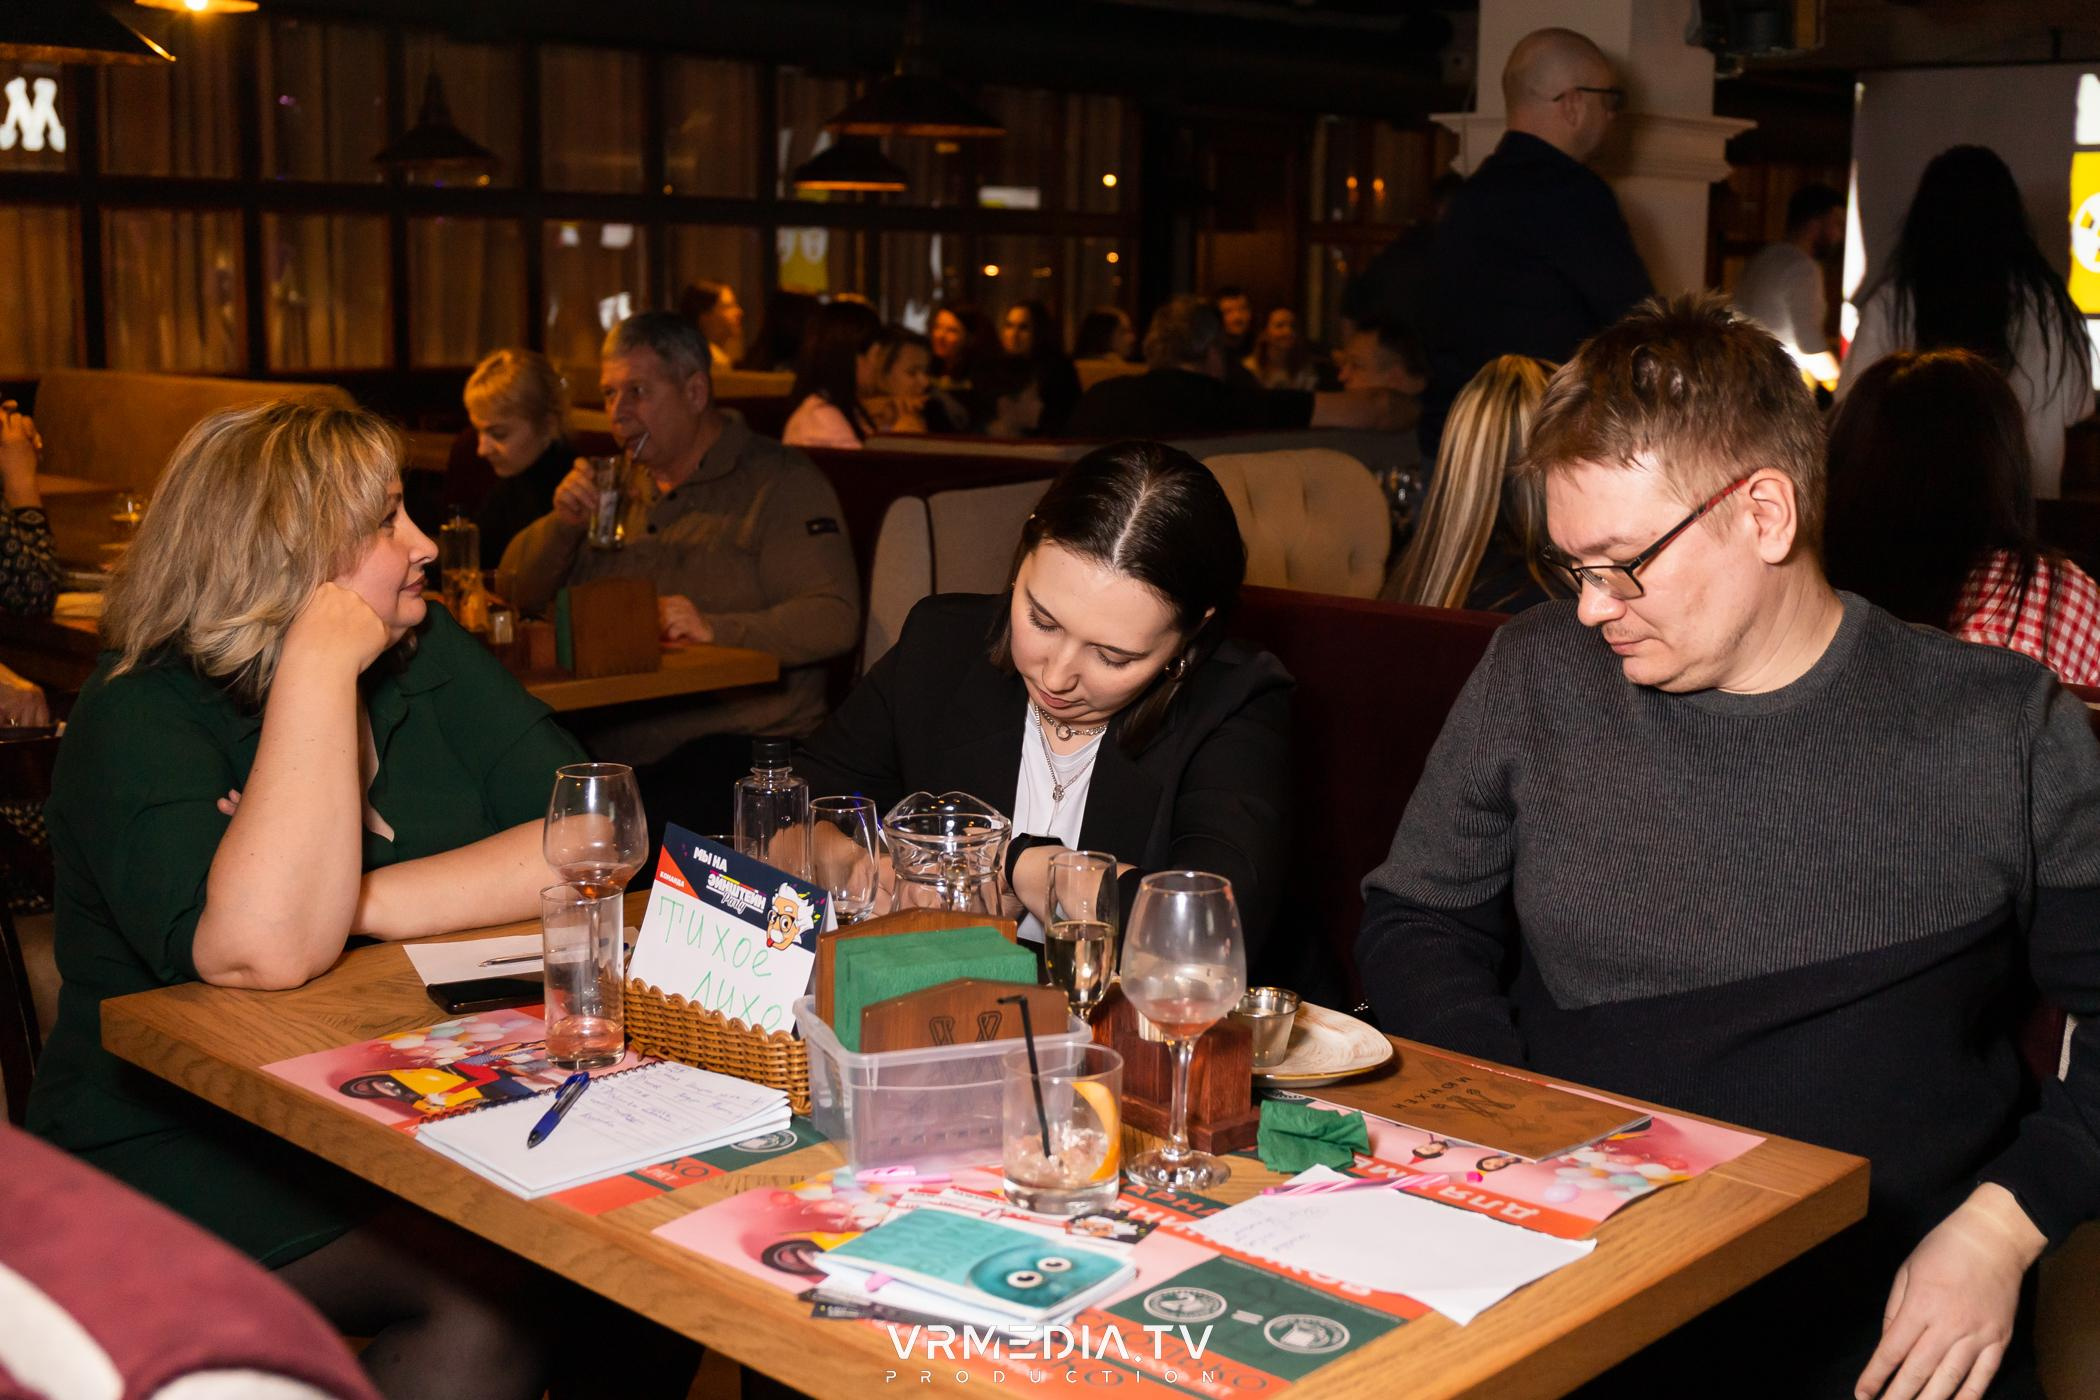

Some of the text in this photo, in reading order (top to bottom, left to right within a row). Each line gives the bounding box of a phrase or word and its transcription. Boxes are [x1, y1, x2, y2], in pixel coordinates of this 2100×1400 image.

[693, 846, 728, 873] МЫ НА
[660, 871, 685, 888] КОМАНДА
[1438, 1186, 1540, 1219] ДЛЯ
